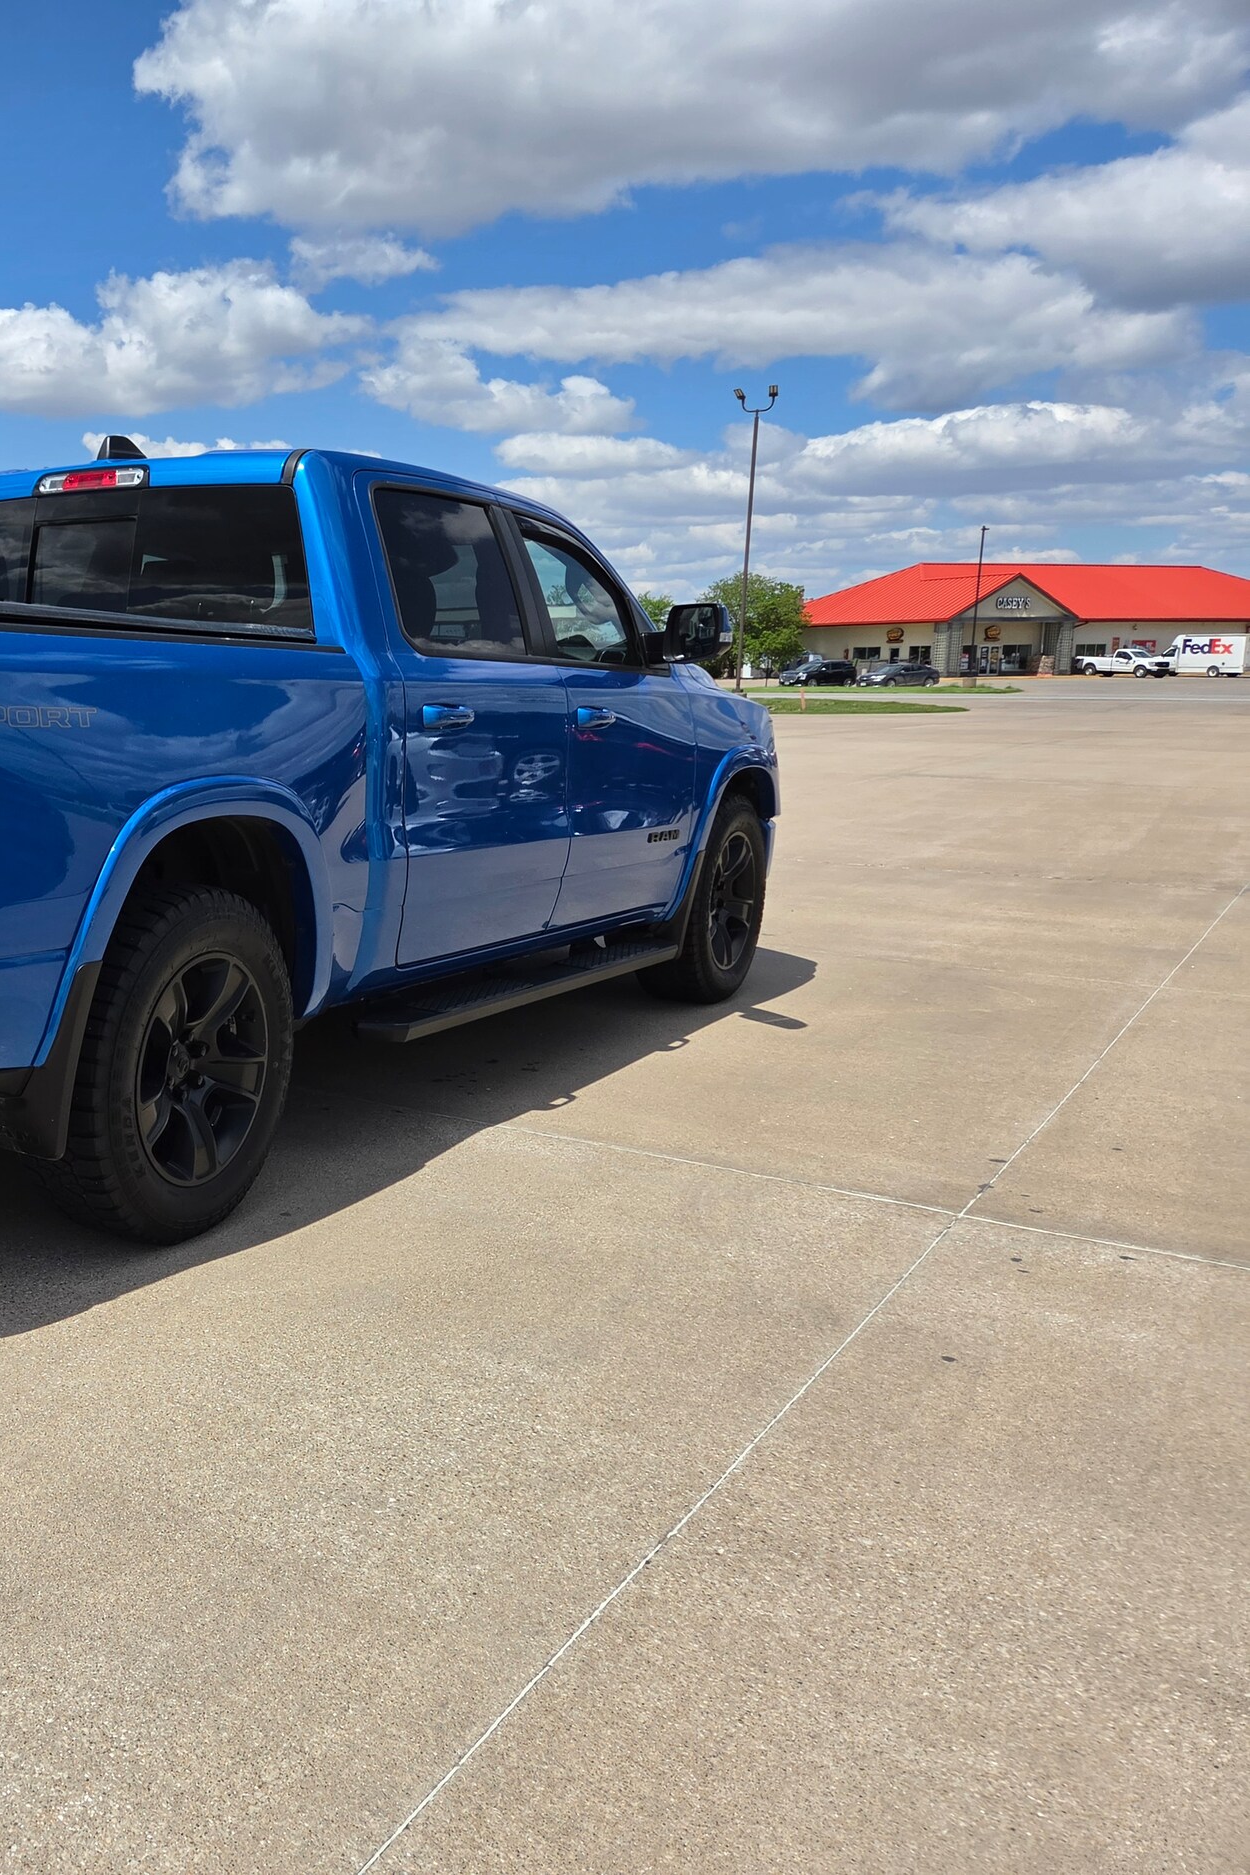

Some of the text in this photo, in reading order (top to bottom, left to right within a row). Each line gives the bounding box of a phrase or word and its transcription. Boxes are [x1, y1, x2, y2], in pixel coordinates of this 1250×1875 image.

[996, 597, 1031, 610] CASEY'S
[1181, 638, 1234, 654] FedEx
[647, 829, 680, 844] RAM
